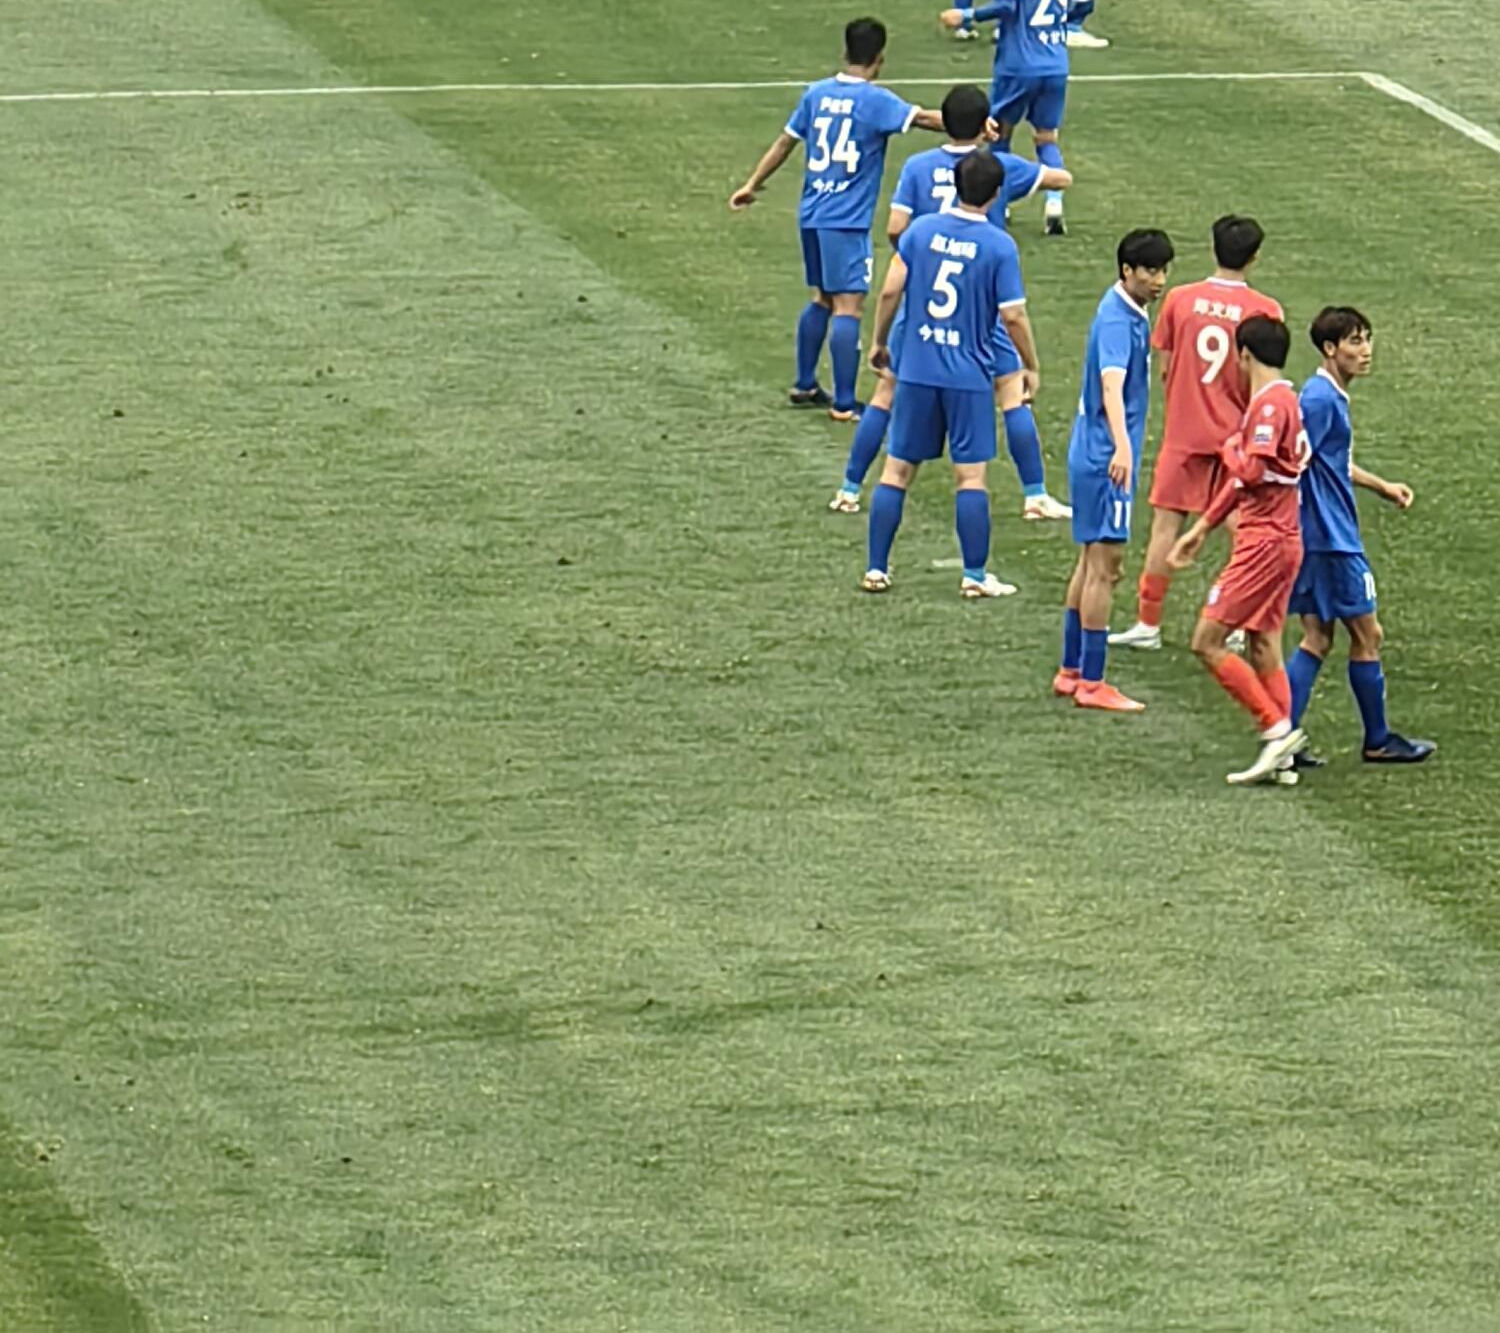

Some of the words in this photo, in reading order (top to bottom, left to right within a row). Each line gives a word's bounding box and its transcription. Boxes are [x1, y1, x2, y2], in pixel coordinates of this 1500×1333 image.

[808, 116, 861, 173] 34
[927, 259, 964, 319] 5
[1196, 324, 1230, 384] 9
